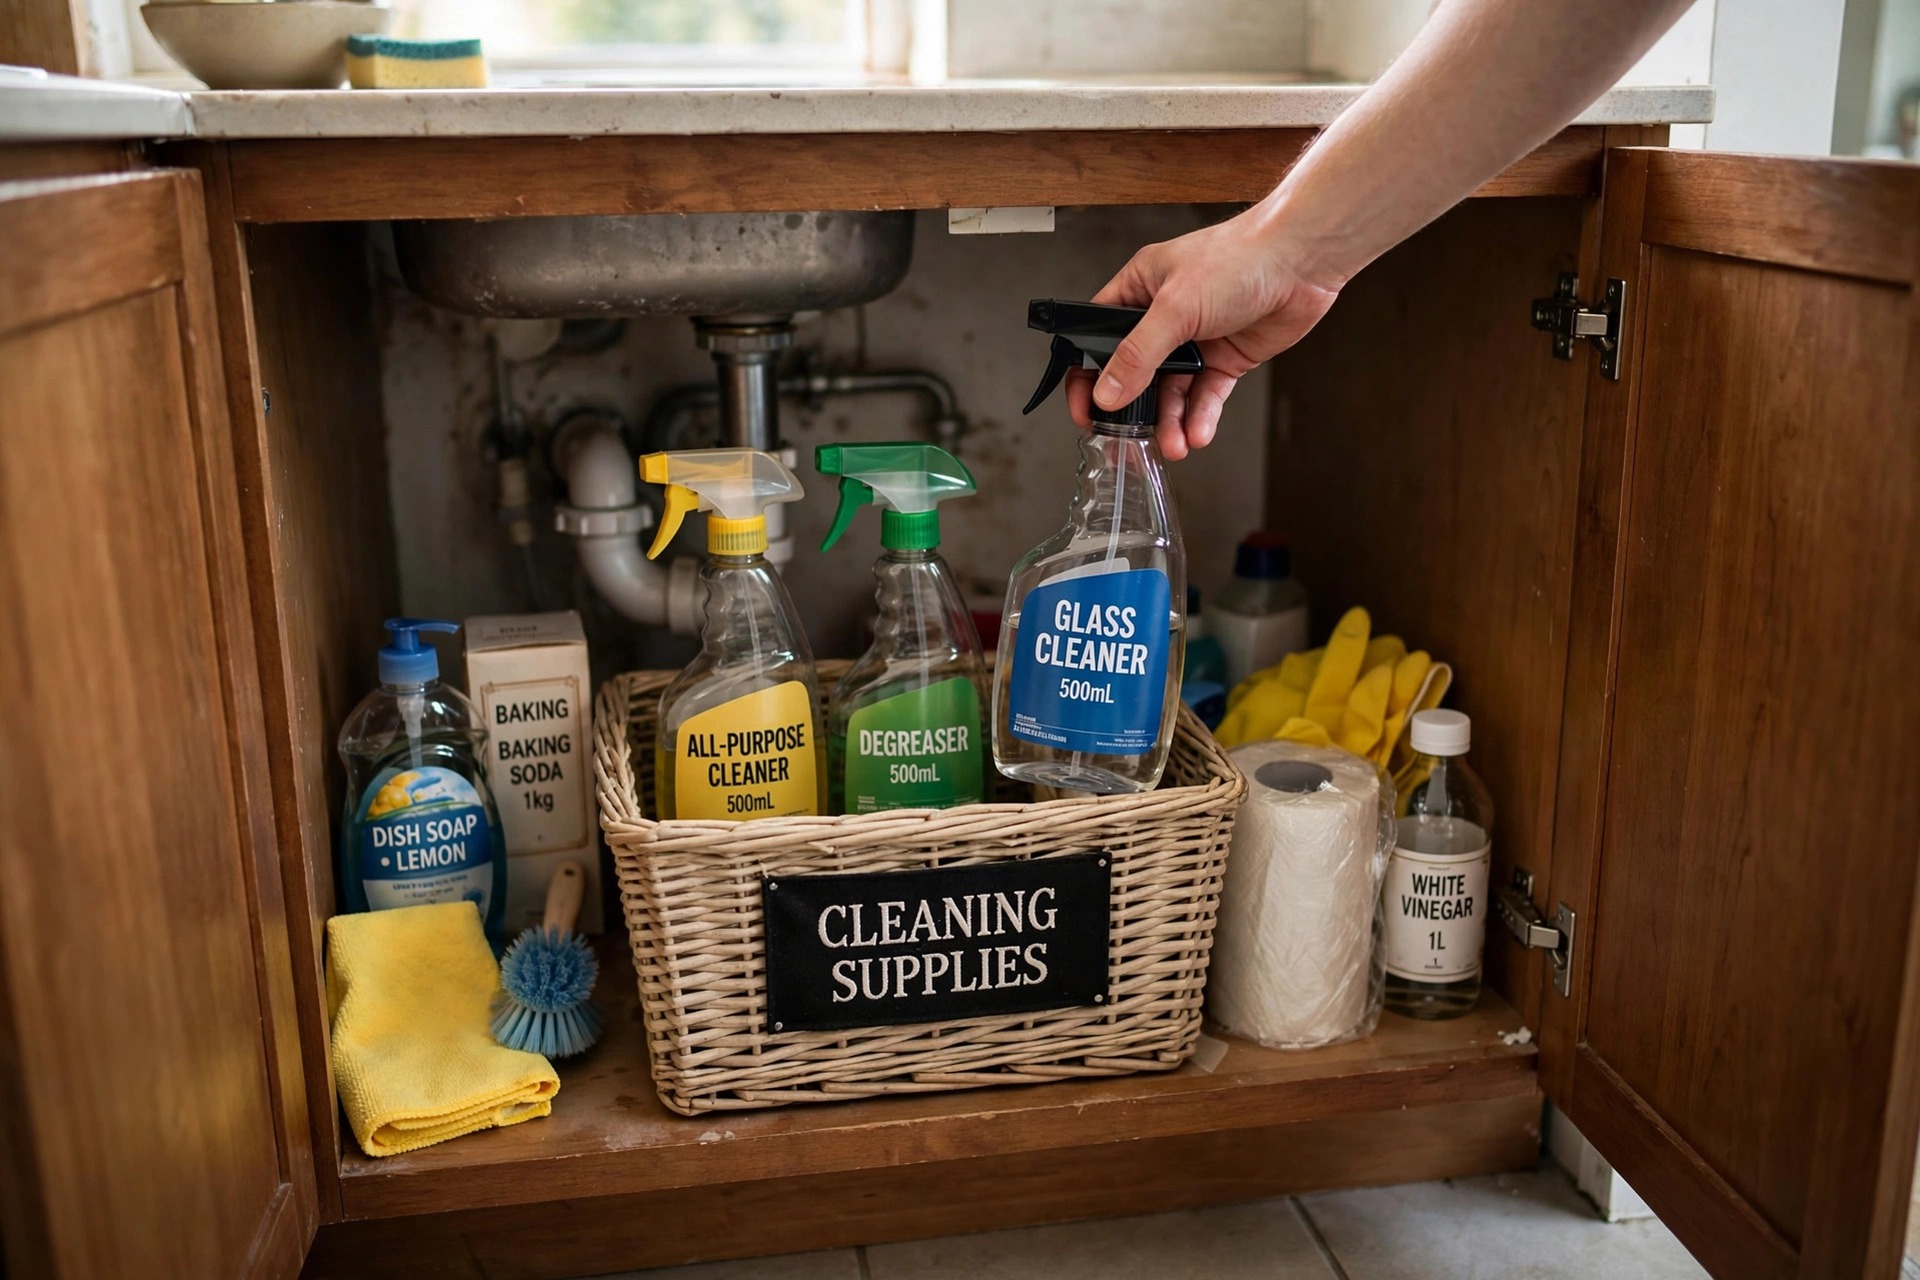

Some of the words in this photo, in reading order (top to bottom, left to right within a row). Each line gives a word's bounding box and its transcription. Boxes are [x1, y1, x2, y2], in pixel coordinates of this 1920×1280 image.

[1054, 599, 1136, 639] GLASS
[1035, 632, 1148, 676] CLEANER
[1058, 677, 1115, 704] 500mL
[495, 698, 569, 725] BAKING
[498, 734, 571, 761] BAKING
[687, 723, 805, 758] ALL-PURPOSE
[859, 725, 969, 757] DEGREASER
[510, 761, 563, 785] SODA
[708, 757, 789, 788] CLEANER
[889, 763, 941, 784] 500mL
[524, 789, 554, 813] 1kg
[727, 791, 775, 814] 500mL
[372, 823, 421, 848] DISH
[425, 814, 477, 843] SOAP
[396, 841, 466, 872] LEMON
[1411, 873, 1466, 897] WHITE
[817, 886, 1058, 949] CLEANING
[1401, 894, 1474, 921] VINEGAR
[1428, 930, 1446, 950] 1L
[831, 942, 1049, 1004] SUPPLIES
